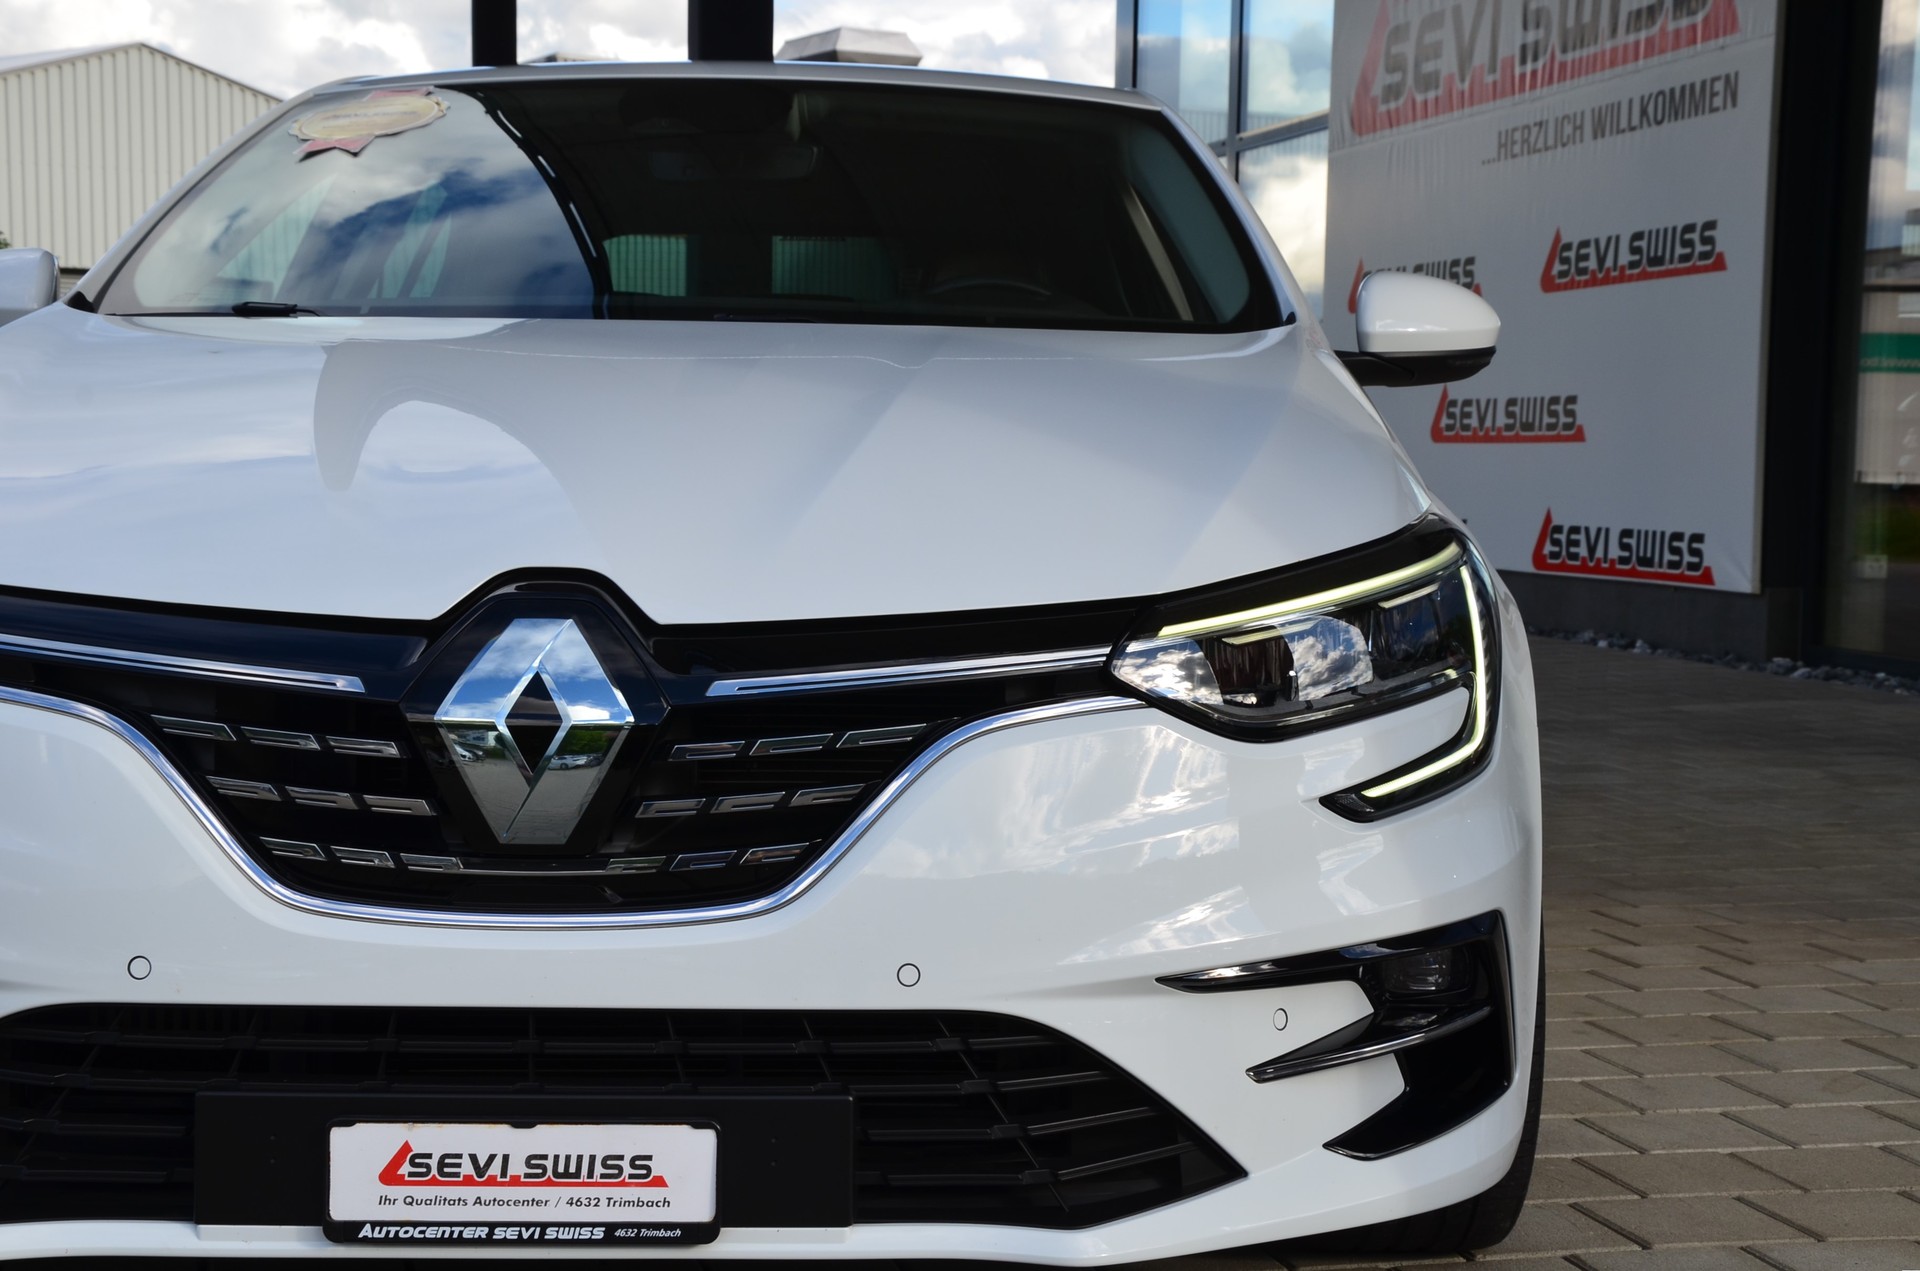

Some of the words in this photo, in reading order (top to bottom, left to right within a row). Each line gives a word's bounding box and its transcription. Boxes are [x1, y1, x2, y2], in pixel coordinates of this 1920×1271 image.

[1381, 0, 1503, 105] SEVI
[1591, 70, 1739, 141] WILLKOMMEN
[1556, 233, 1621, 281] SEVI
[1627, 219, 1718, 272] SWISS
[1445, 399, 1499, 432] SEVI
[1504, 395, 1578, 432] SWISS
[1548, 525, 1610, 564] SEVI
[1617, 528, 1706, 573] SWISS
[407, 1152, 510, 1179] SEVI
[523, 1153, 654, 1180] SWISS
[378, 1195, 398, 1206] Ihr
[403, 1195, 468, 1207] Qualitats
[472, 1196, 550, 1207] Autocenter
[565, 1197, 601, 1208] 4632
[606, 1197, 671, 1208] Trimbach
[492, 1226, 541, 1239] SEVI
[544, 1226, 606, 1240] SWISS
[614, 1228, 638, 1237] 4632
[639, 1228, 682, 1238] Trimbach
